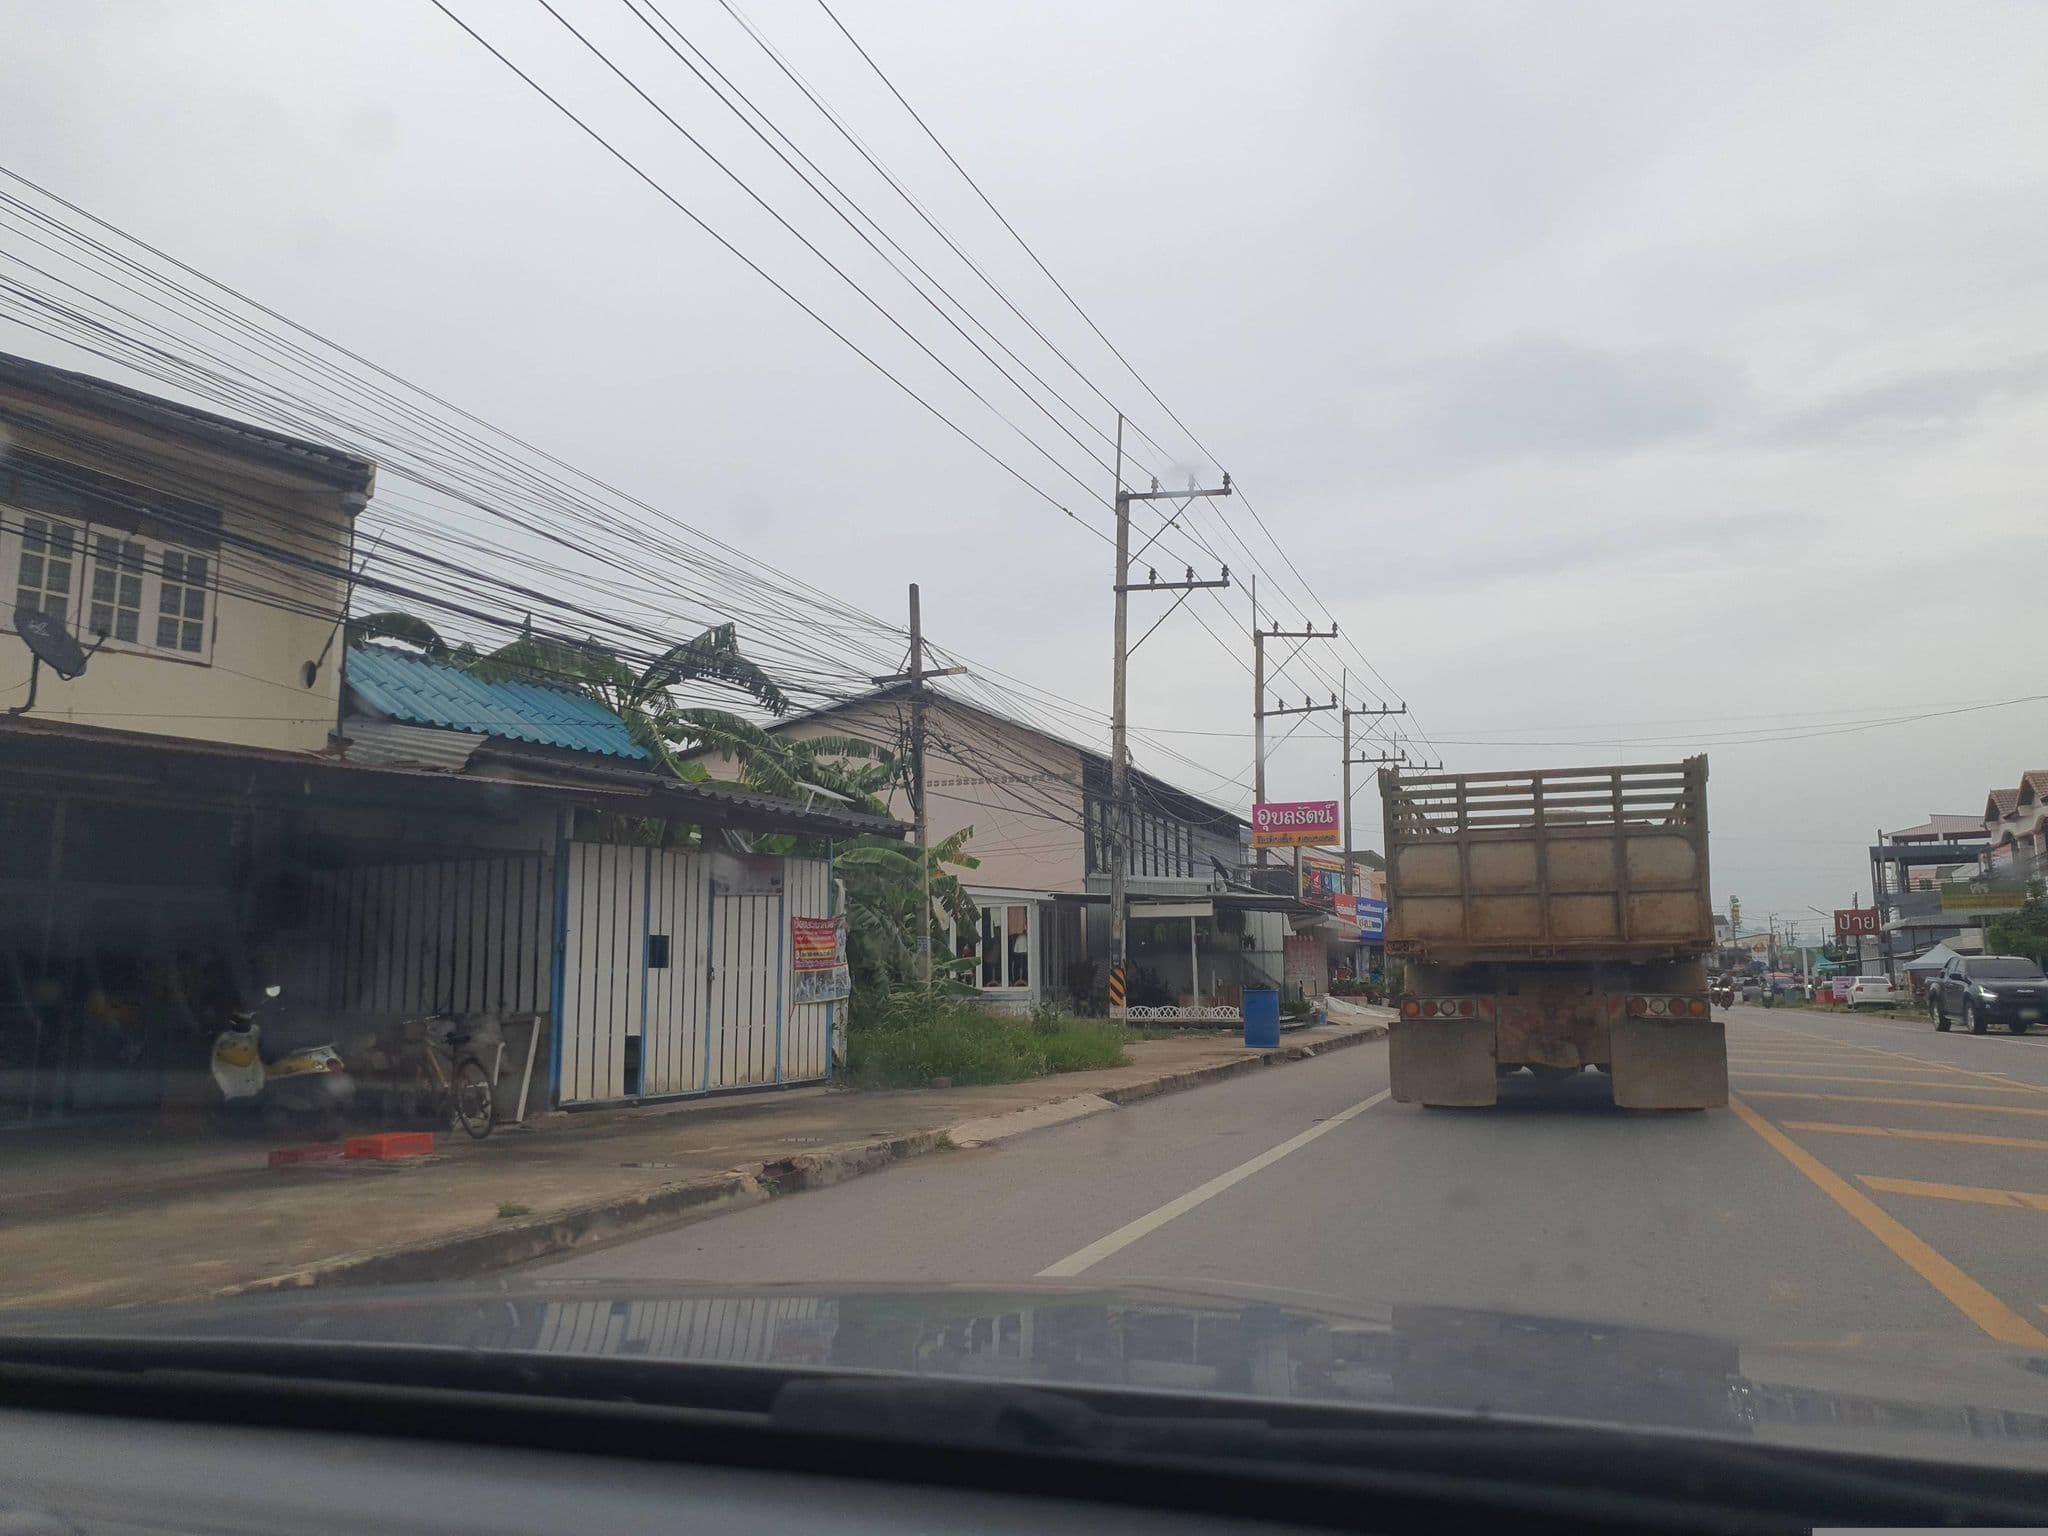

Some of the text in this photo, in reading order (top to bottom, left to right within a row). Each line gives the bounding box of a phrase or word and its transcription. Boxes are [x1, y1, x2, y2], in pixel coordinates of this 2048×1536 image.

[1257, 803, 1334, 831] อุบลรัตน์
[1839, 912, 1874, 930] ป้าย
